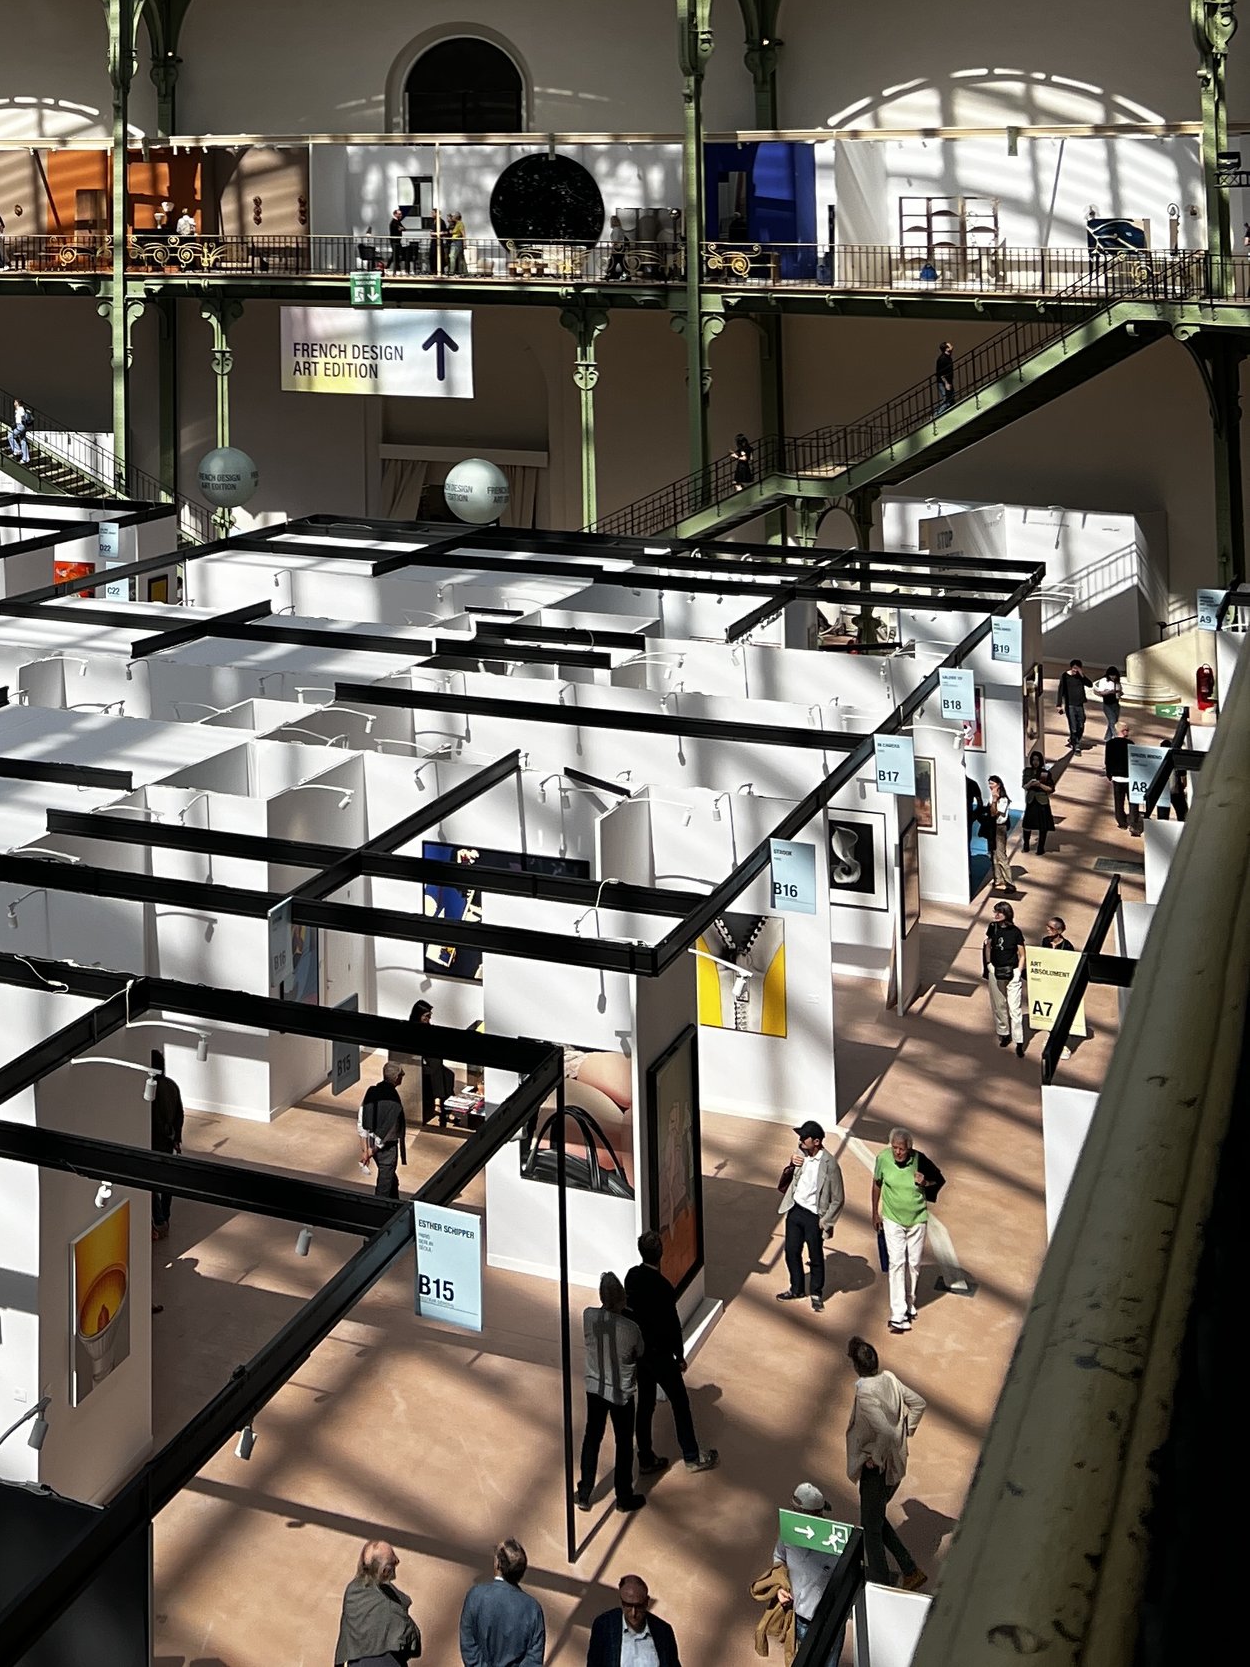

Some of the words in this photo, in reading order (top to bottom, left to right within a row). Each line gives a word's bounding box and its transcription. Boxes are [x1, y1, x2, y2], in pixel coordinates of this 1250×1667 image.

[293, 342, 347, 360] FRENCH
[352, 344, 404, 361] DESIGN
[293, 361, 320, 377] ART
[324, 362, 379, 379] EDITION
[216, 474, 241, 482] DESIGN
[99, 543, 112, 552] D22
[107, 586, 120, 595] C22
[1199, 615, 1212, 624] A9
[992, 643, 1010, 654] B19
[942, 699, 962, 710] B18
[878, 769, 900, 783] B17
[1131, 781, 1148, 793] A8
[773, 881, 798, 898] B16
[274, 950, 287, 971] B16
[1030, 967, 1070, 978] ABSOLUMENT
[1032, 1000, 1054, 1017] A7
[337, 1054, 351, 1077] B15
[418, 1219, 442, 1232] ESTHER
[443, 1225, 475, 1240] SCHIPPER
[418, 1273, 455, 1302] B15
